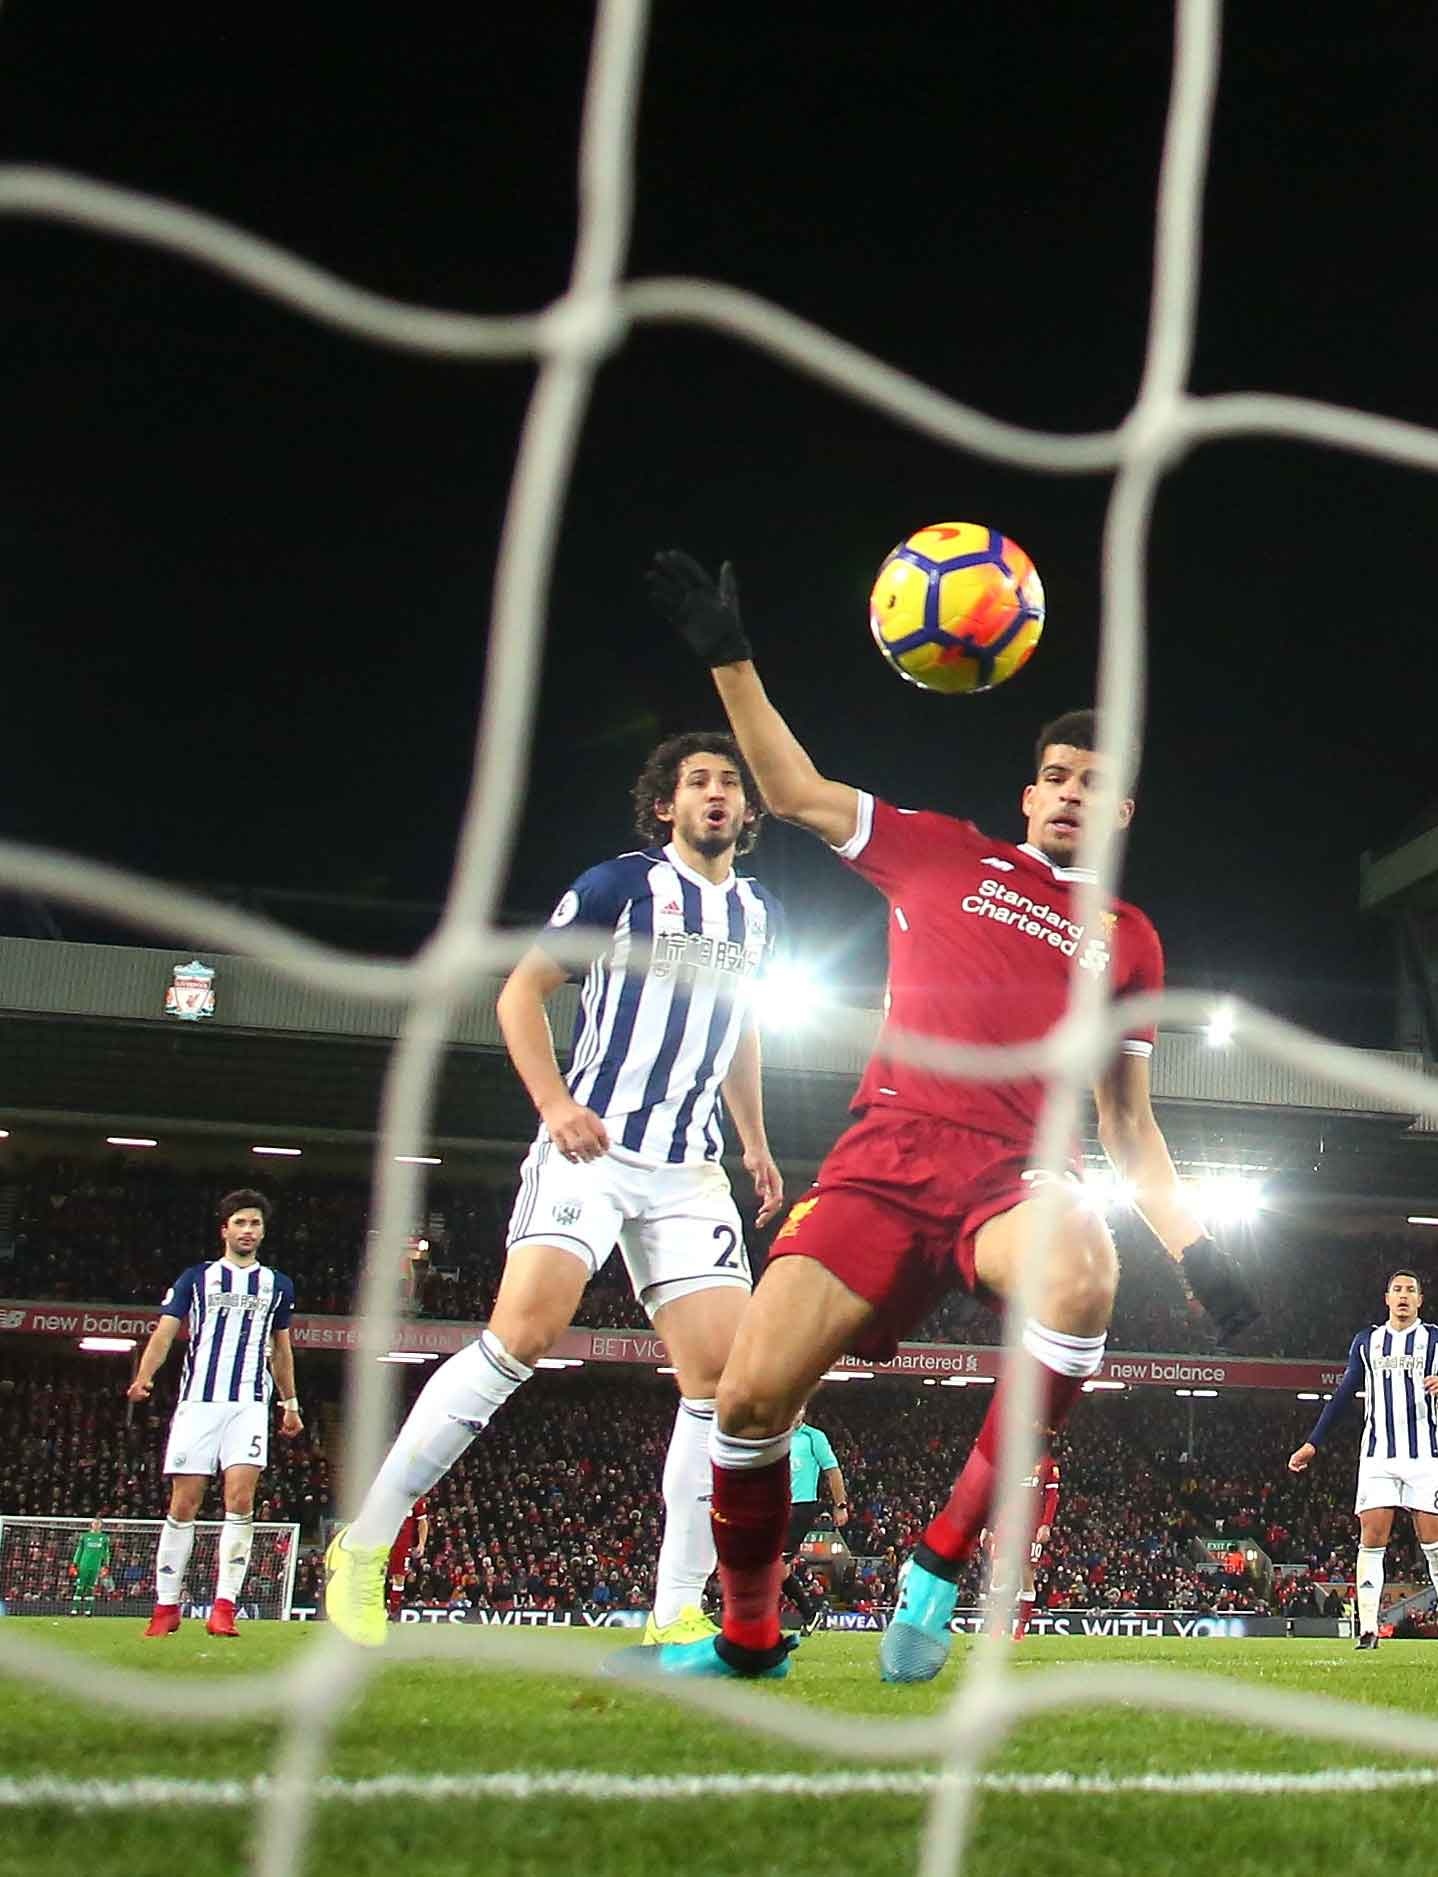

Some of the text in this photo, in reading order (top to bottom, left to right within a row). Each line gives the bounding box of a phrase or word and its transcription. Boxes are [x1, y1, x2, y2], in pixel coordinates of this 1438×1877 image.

[978, 879, 1085, 940] Standard
[961, 895, 1079, 957] Chartered
[712, 1224, 747, 1273] 2
[32, 1313, 79, 1331] new
[82, 1313, 160, 1334] balanc
[592, 1337, 666, 1359] BETVIC
[1110, 1361, 1225, 1382] new balance
[248, 1435, 262, 1458] 5
[479, 1610, 571, 1628] WITH
[826, 1615, 879, 1629] NIVEA
[1081, 1619, 1163, 1637] WITH
